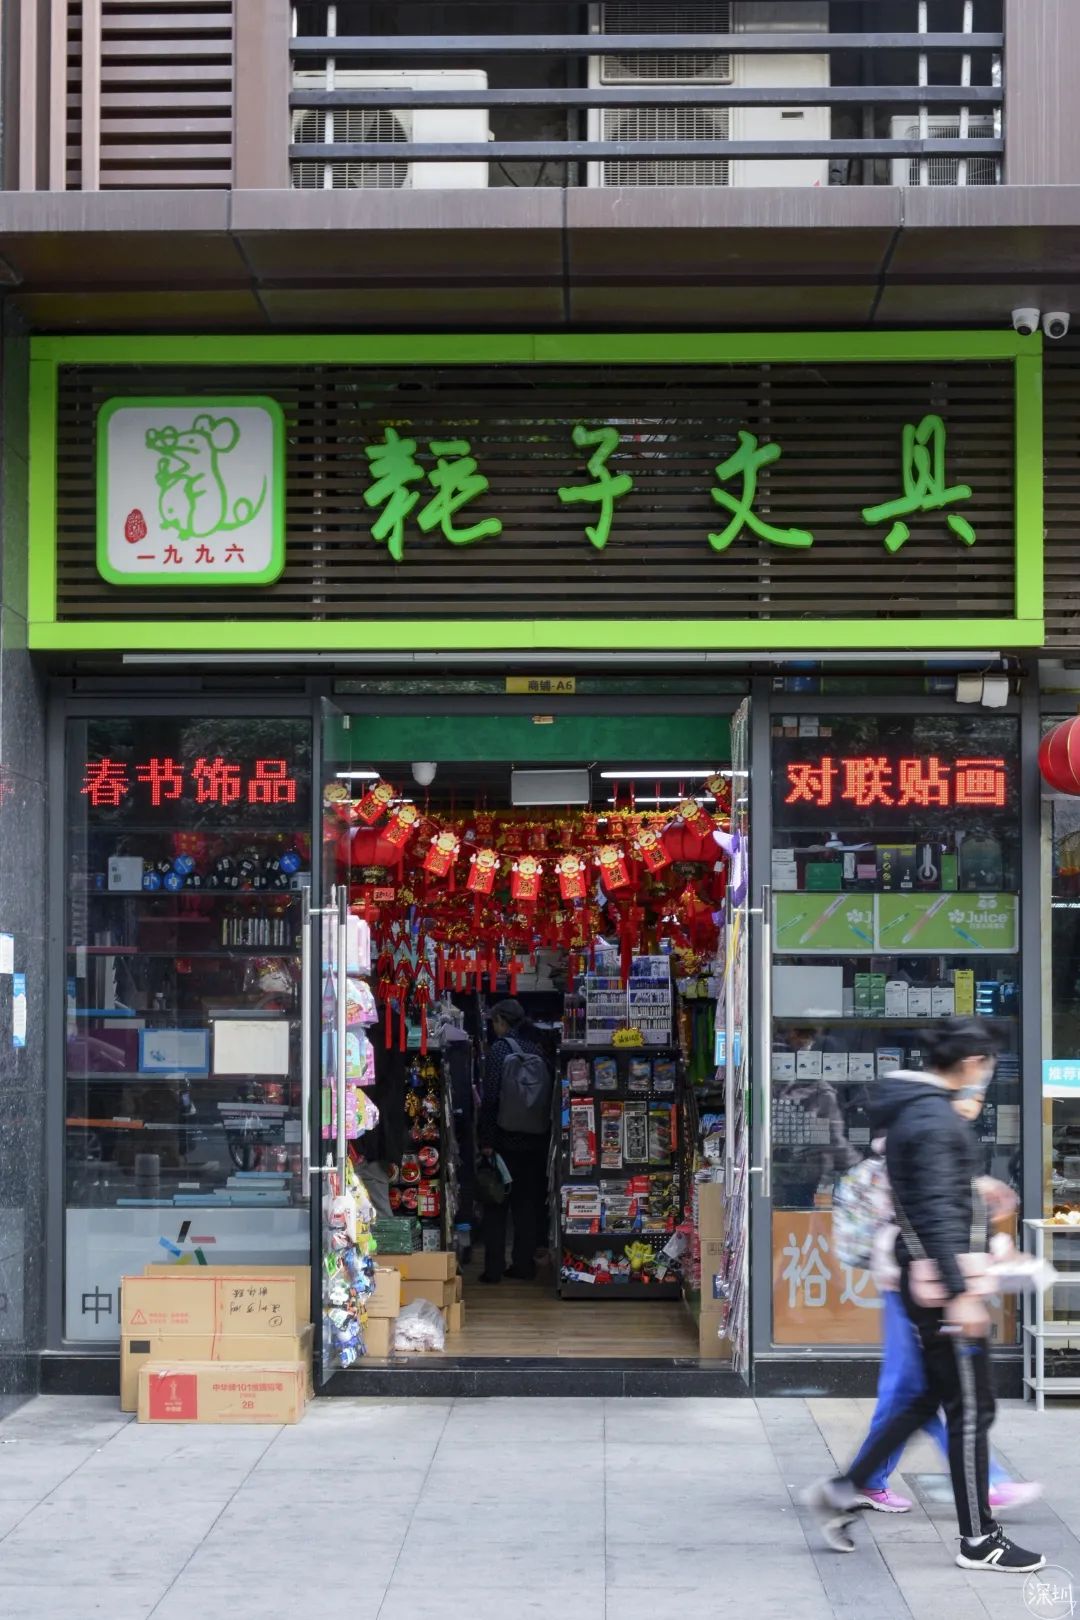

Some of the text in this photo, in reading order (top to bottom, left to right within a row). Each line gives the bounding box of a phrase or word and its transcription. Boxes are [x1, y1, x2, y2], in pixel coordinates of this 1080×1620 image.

[364, 414, 976, 562] 耗子文具
[137, 543, 244, 564] 一九九六
[528, 680, 573, 691] 商铺-A6
[80, 757, 297, 807] 春节饰品
[784, 756, 1007, 807] 对联贴画
[965, 910, 1008, 924] Juice
[1048, 1065, 1080, 1081] 推荐
[241, 1400, 254, 1409] 2B
